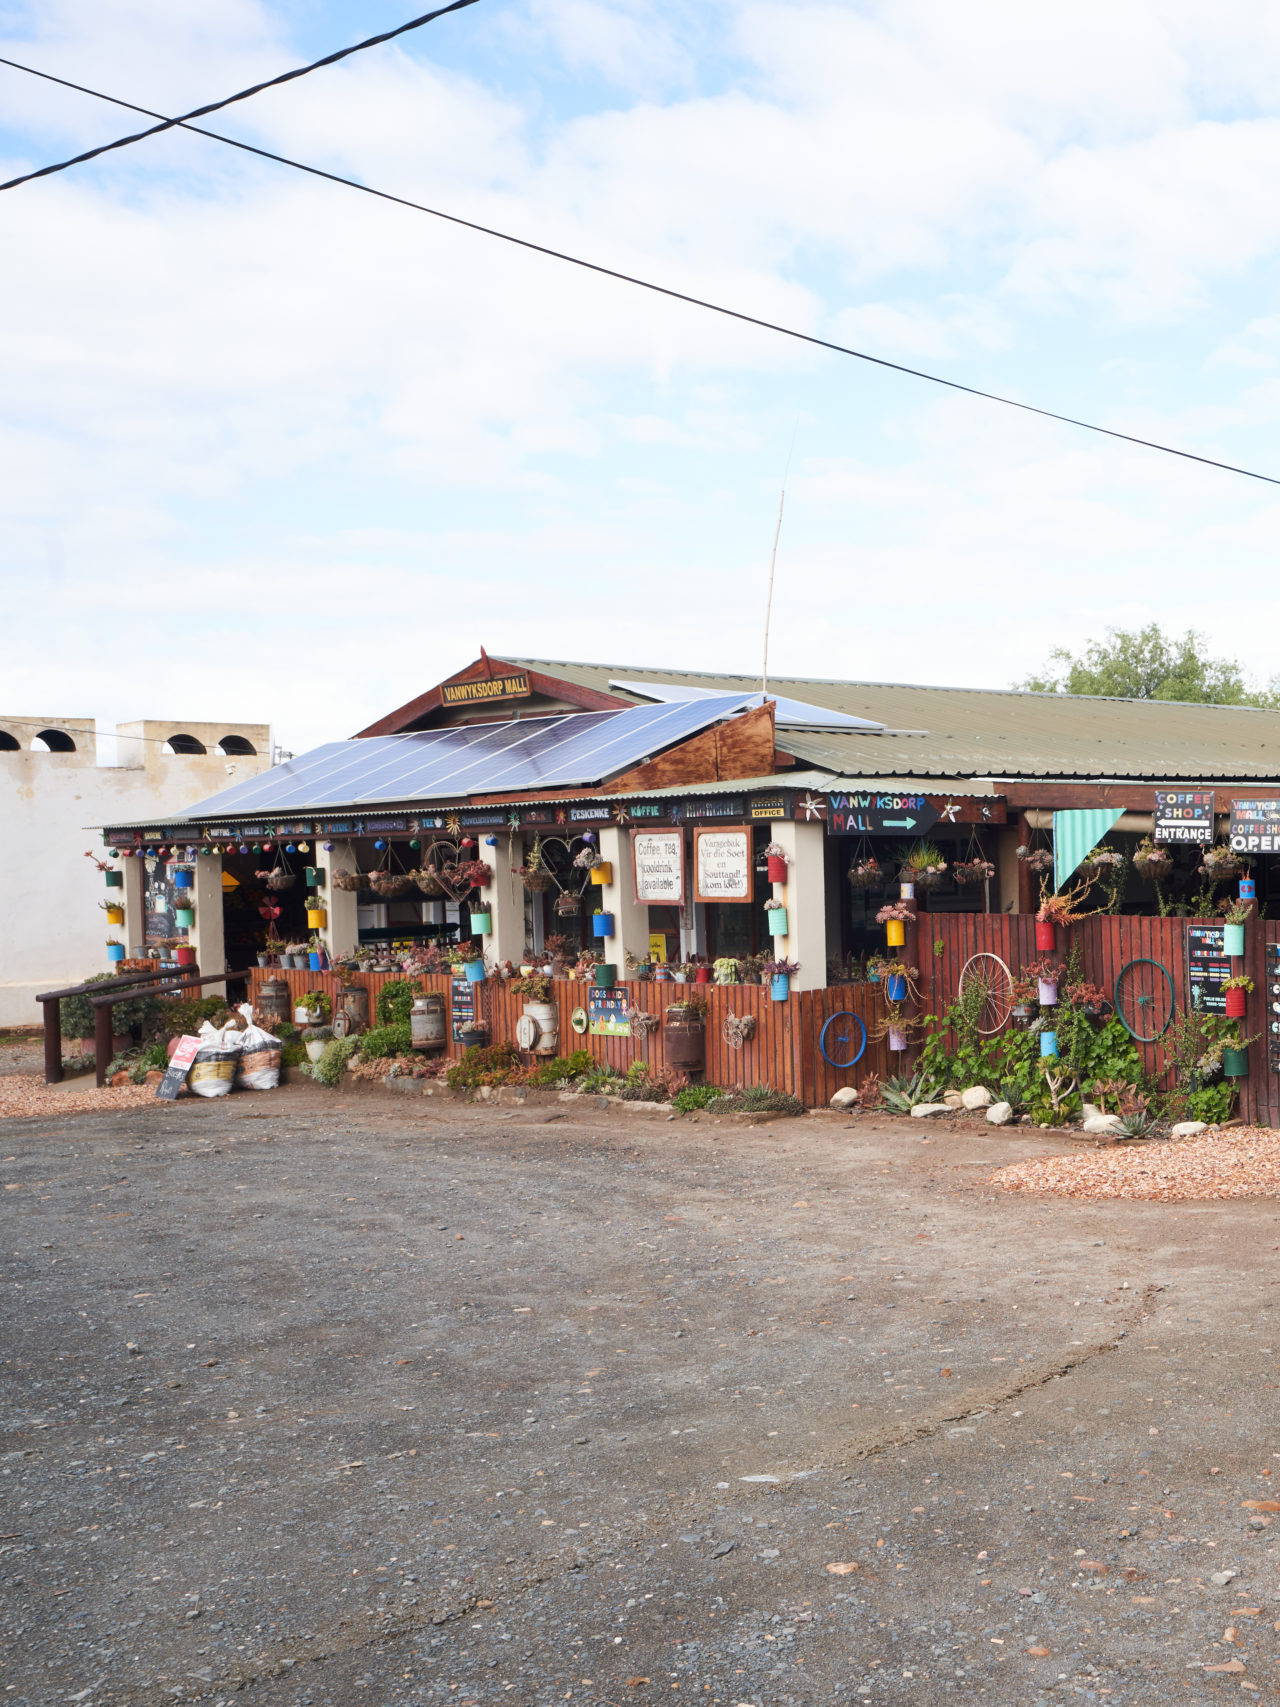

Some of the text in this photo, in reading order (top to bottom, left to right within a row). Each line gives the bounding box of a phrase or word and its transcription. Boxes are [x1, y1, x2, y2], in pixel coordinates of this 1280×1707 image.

[444, 677, 527, 701] VANWYKSDORP MALL
[830, 795, 926, 811] VANWYKSDORP
[1157, 793, 1211, 804] COFFEE
[570, 807, 610, 821] GESKENKE
[630, 805, 660, 817] KOFFIE
[754, 809, 782, 817] OFFICE
[1165, 808, 1203, 819] SHOP
[1235, 810, 1265, 820] MALL
[833, 813, 875, 831] MALL
[1155, 827, 1212, 840] ENTRANCE
[1232, 824, 1265, 834] COFFEE
[726, 849, 745, 857] Soet
[644, 877, 674, 891] available
[592, 989, 606, 999] DOGS
[612, 990, 625, 999] KIDS
[595, 1000, 622, 1009] FRIENDLY
